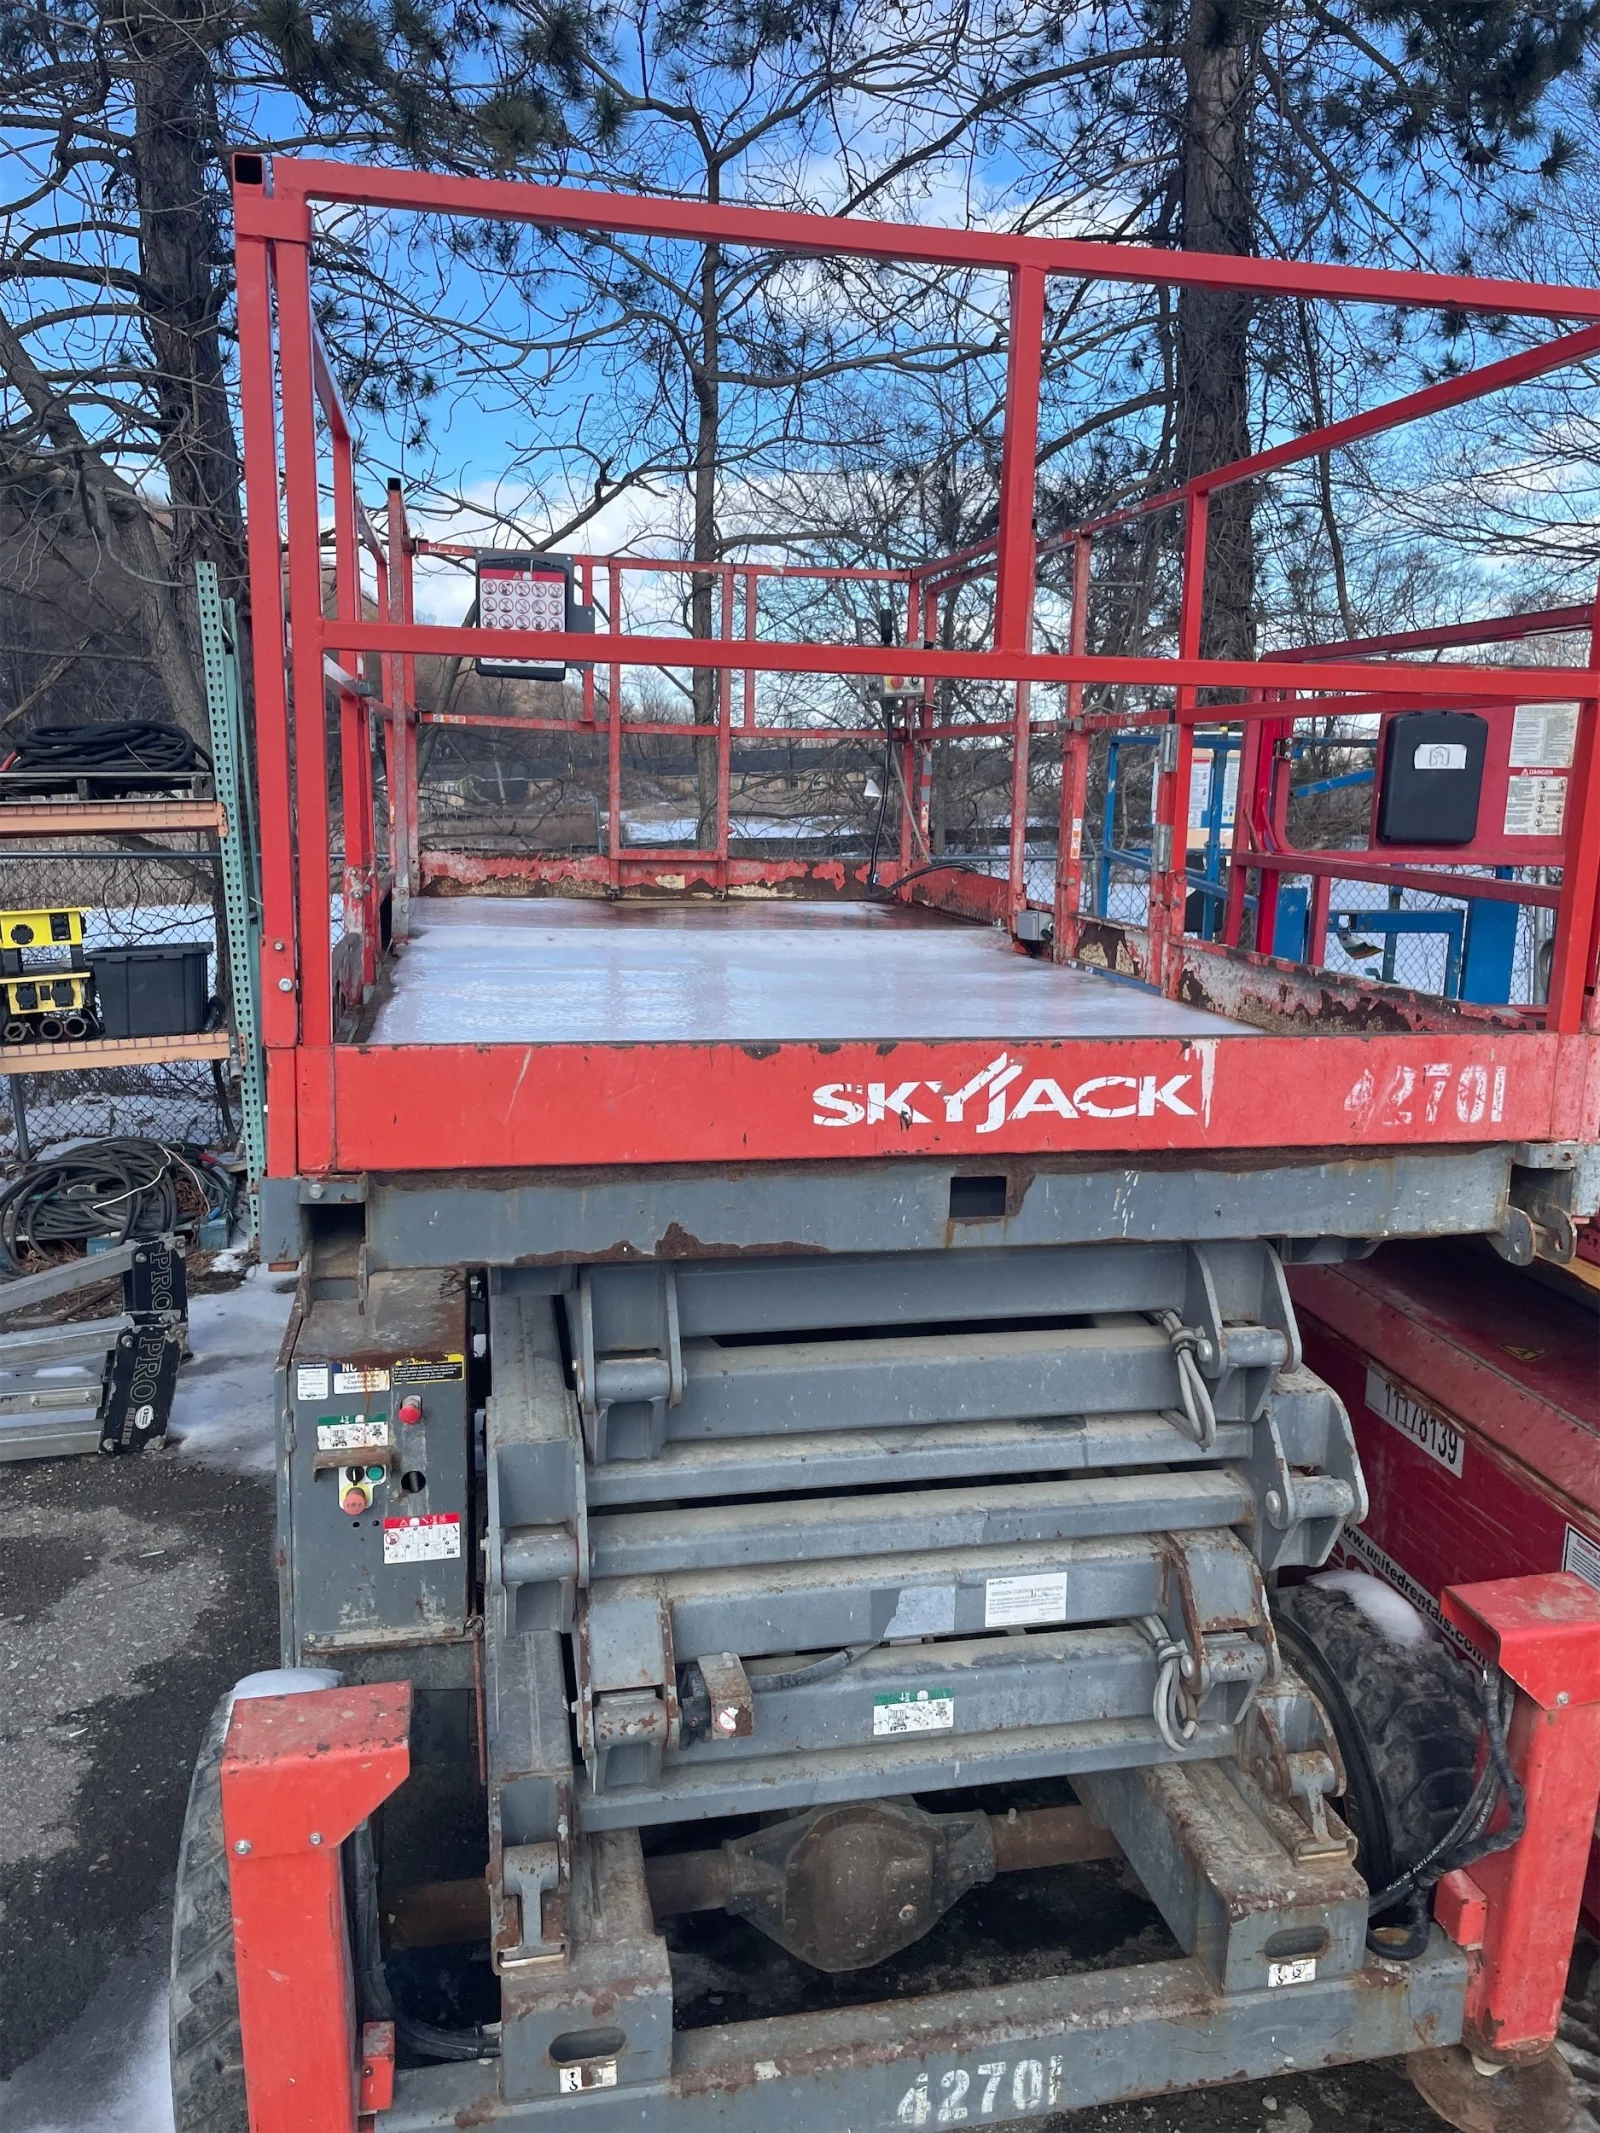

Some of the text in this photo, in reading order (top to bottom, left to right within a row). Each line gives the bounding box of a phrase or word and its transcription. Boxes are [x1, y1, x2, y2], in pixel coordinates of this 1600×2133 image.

[812, 1051, 1198, 1134] SKYJACK
[1343, 1062, 1507, 1128] 42701
[150, 1250, 173, 1311] PRO
[130, 1335, 165, 1404] PRO
[121, 1407, 136, 1445] SERIES
[1343, 1522, 1487, 1666] ww.unitedrentals.com
[897, 2055, 1064, 2125] 42701
